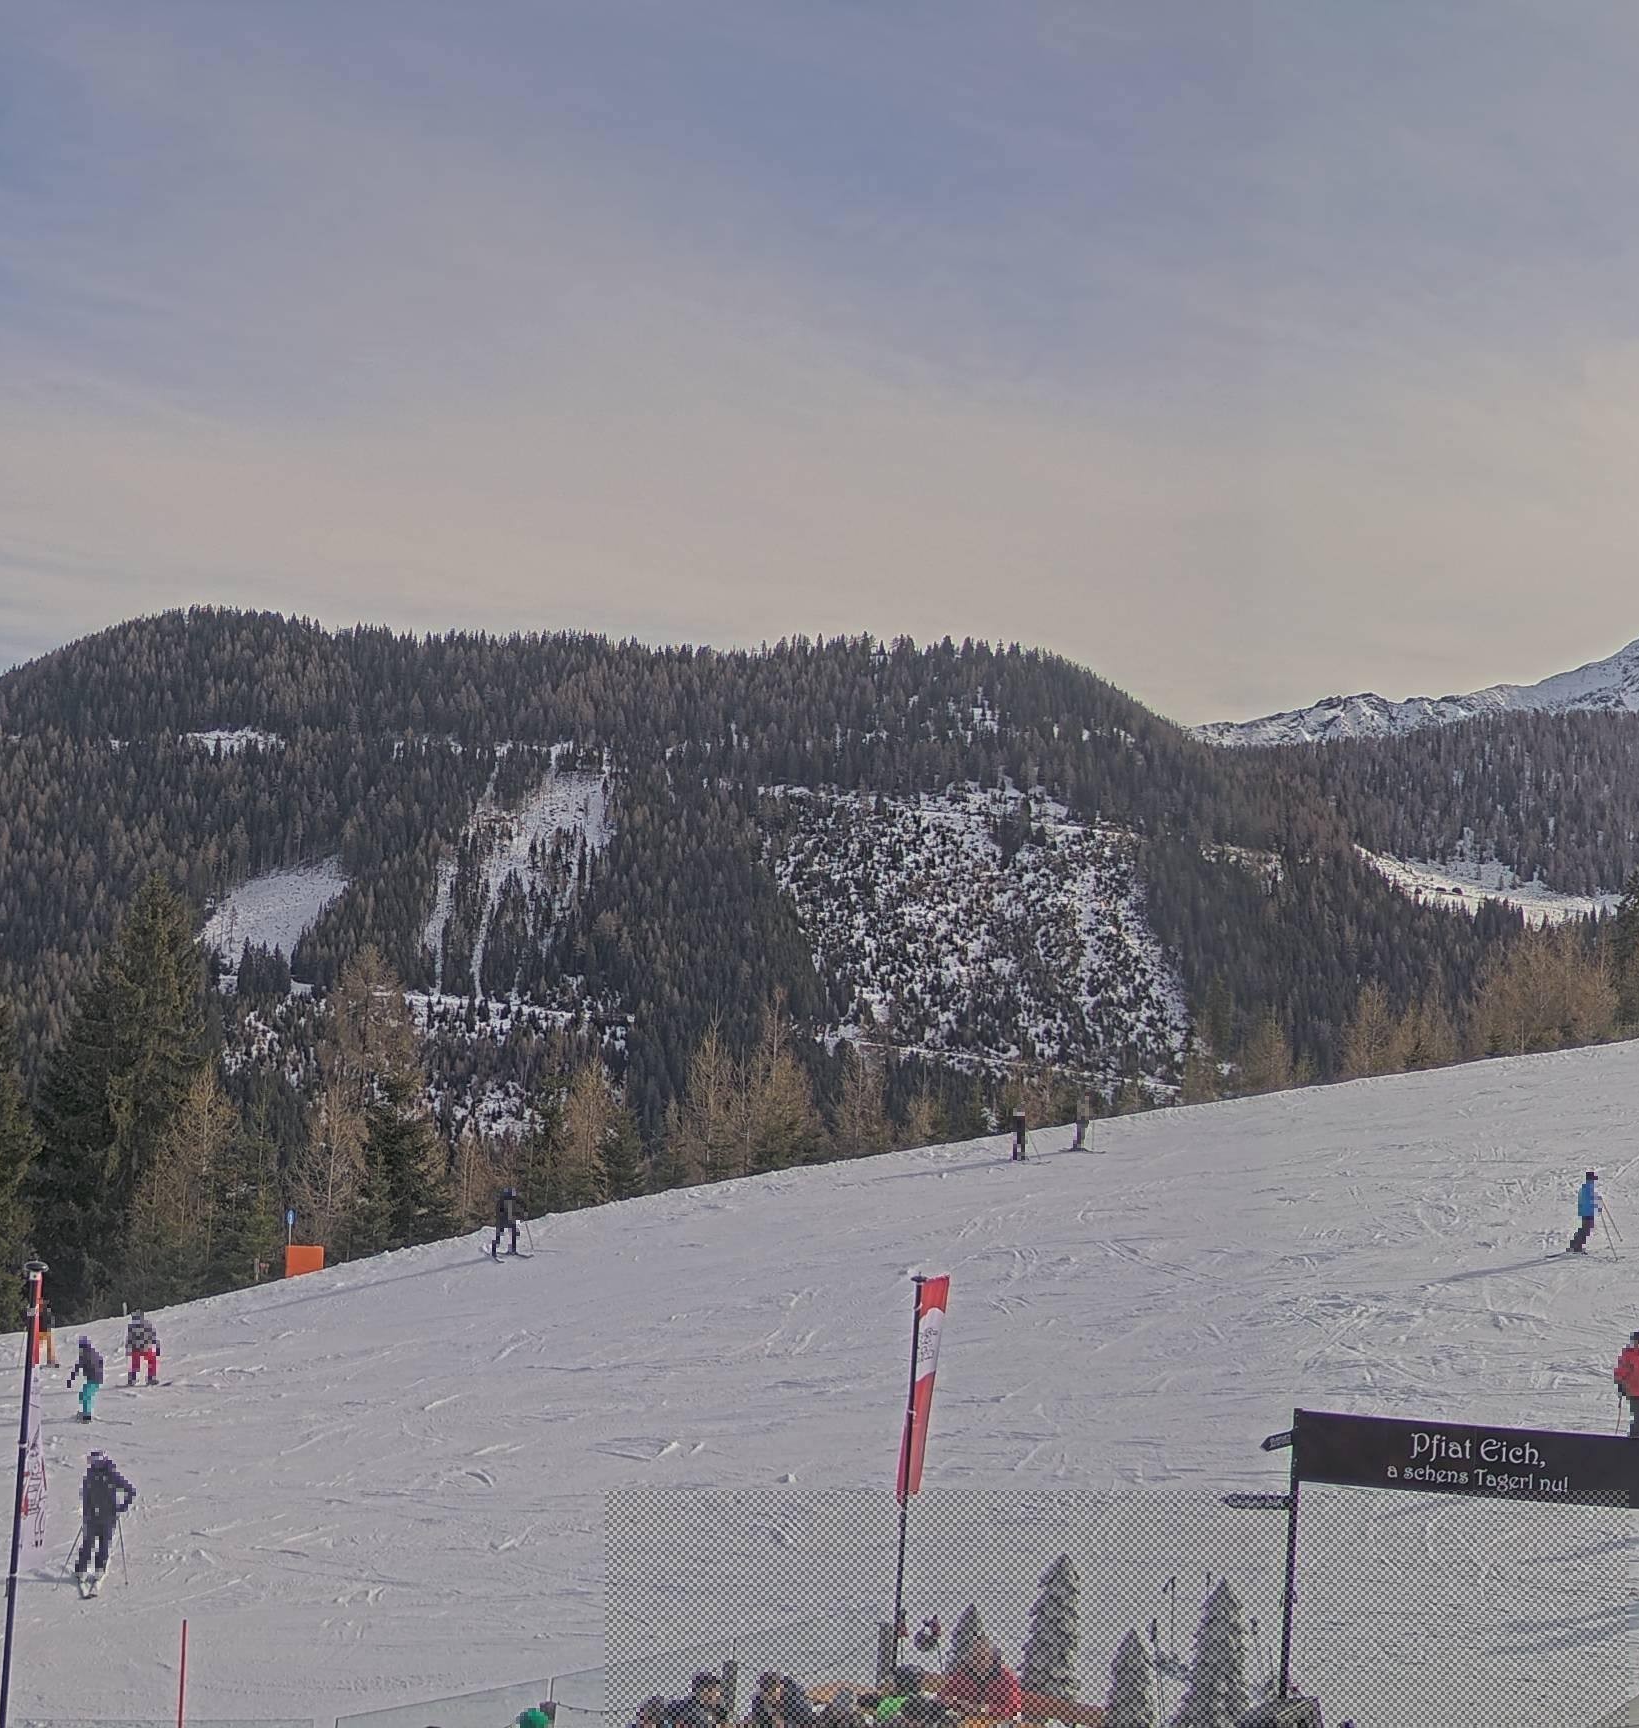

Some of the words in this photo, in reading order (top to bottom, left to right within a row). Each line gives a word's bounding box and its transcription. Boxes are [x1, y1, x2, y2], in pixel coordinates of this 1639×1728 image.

[1410, 1432, 1471, 1462] Pfiat
[1480, 1438, 1547, 1468] Eich,
[1387, 1465, 1398, 1478] a
[1403, 1465, 1469, 1485] schens
[1474, 1468, 1533, 1492] Tagerl
